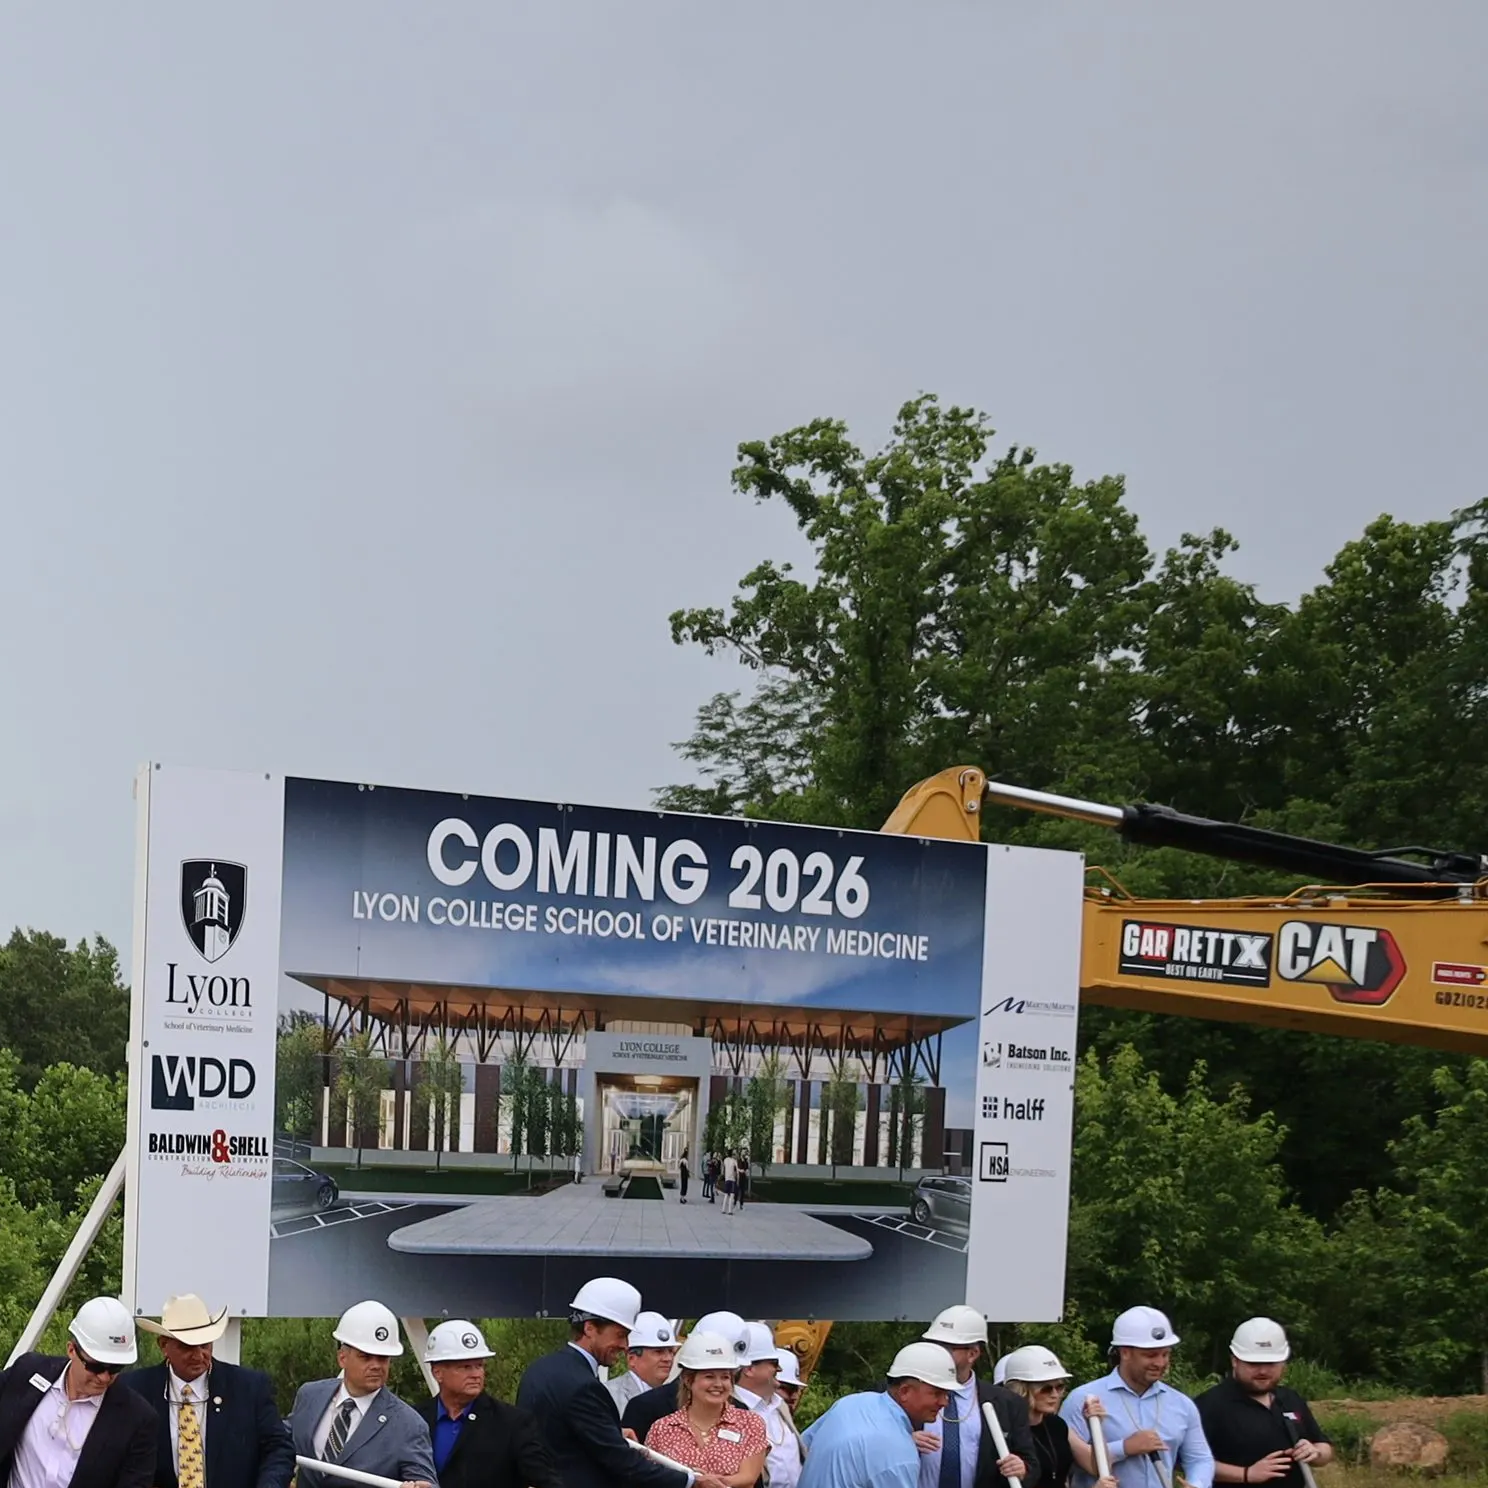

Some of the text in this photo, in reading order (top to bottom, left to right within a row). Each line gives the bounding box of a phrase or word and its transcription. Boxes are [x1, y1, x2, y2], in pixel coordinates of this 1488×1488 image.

[427, 818, 870, 919] COMING 2026
[353, 890, 928, 961] LYON COLLEGE SCHOOL OF VETERINARY MEDICINE
[1277, 920, 1377, 987] CAT
[1166, 964, 1223, 980] BEST ON EARTH
[165, 963, 253, 1014] Lyon
[164, 1022, 184, 1030] School
[192, 1023, 224, 1033] Veterinary
[226, 1025, 253, 1033] Medicine
[620, 1041, 680, 1054] LYON COLLEGE
[1008, 1043, 1071, 1061] Batson Inc.
[151, 1055, 256, 1100] WDD
[1003, 1098, 1044, 1120] halff
[181, 1164, 216, 1180] Building
[989, 1156, 1009, 1175] HSA
